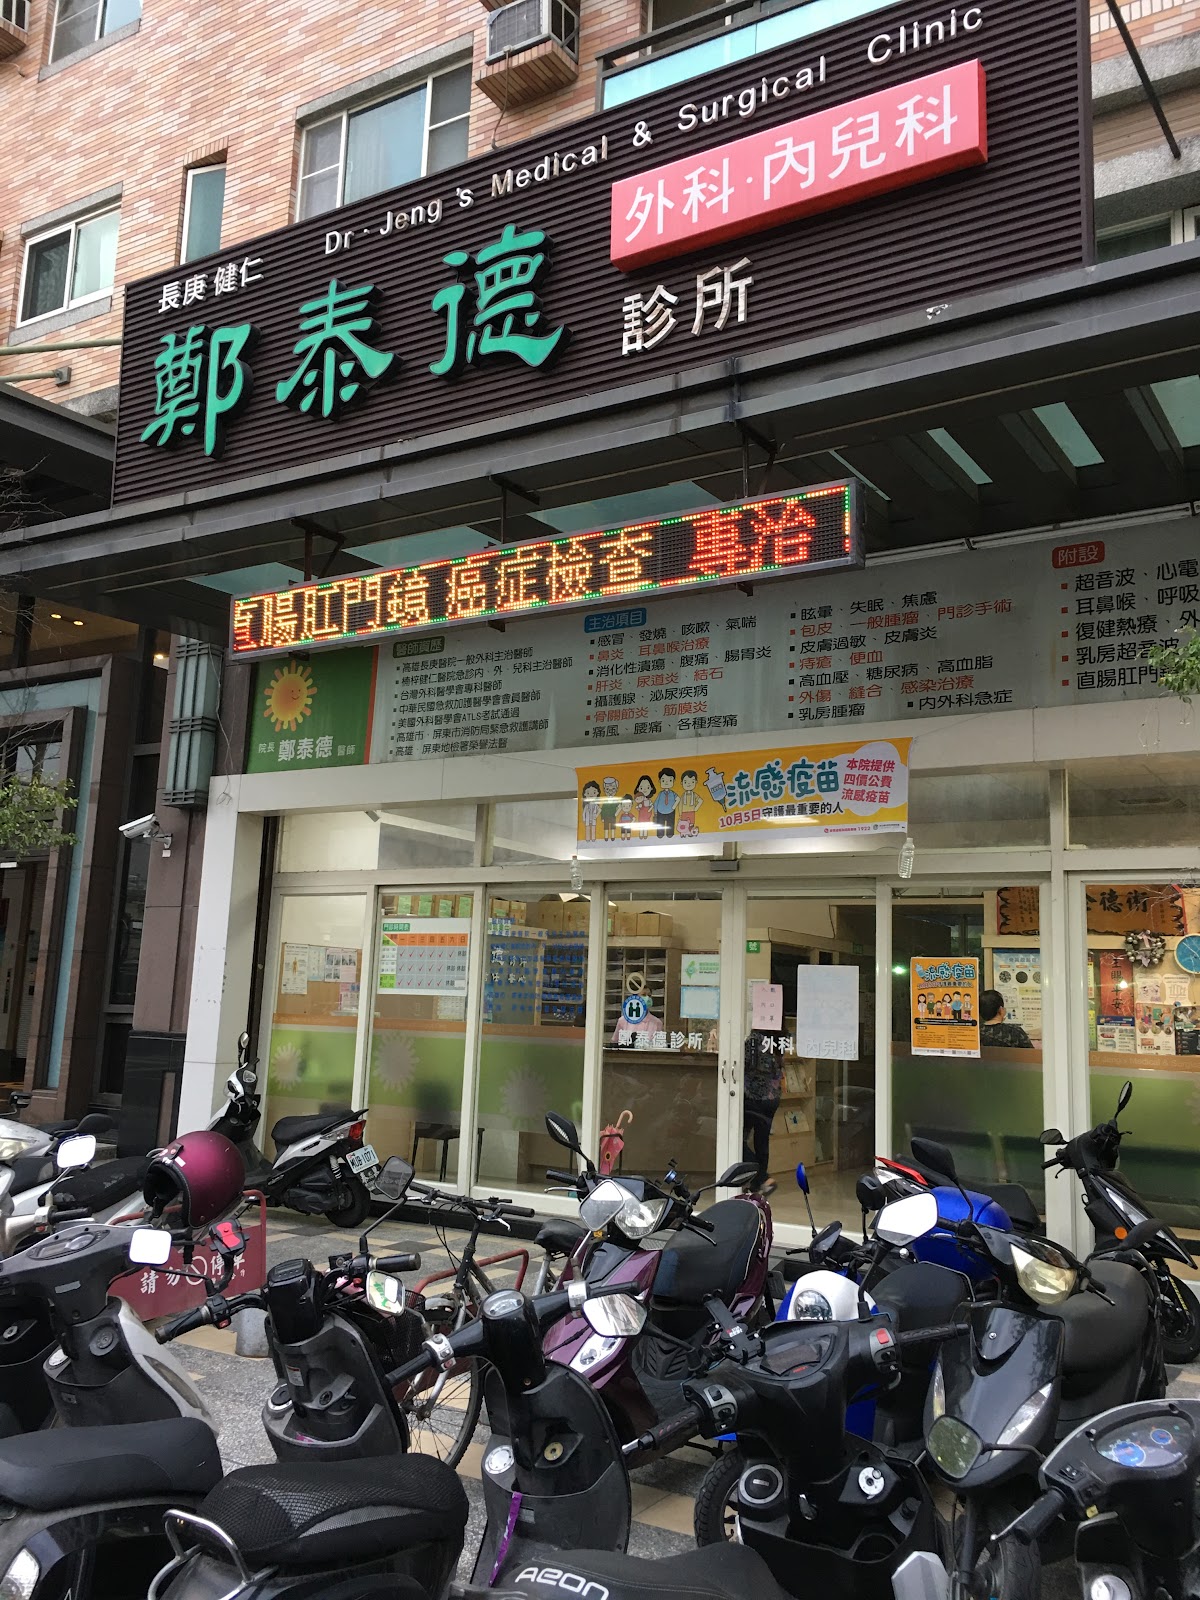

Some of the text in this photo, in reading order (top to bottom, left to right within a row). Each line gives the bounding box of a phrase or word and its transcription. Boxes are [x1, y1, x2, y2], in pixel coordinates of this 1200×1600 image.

[491, 135, 608, 199] Medical
[632, 121, 654, 148] &
[677, 56, 826, 132] Surgical
[867, 6, 983, 65] Clinic
[621, 257, 755, 357] 診所
[140, 224, 566, 457] 鄭泰德
[446, 530, 652, 617] 癌症檢查
[689, 500, 816, 574] 專治
[1058, 544, 1099, 566] 附設
[588, 610, 643, 631] 主治項目
[798, 703, 865, 721] 乳房腫瘤
[278, 735, 334, 762] 鄭泰德
[846, 758, 895, 773] 本院提供
[727, 758, 840, 807] 流感疫苗
[841, 788, 891, 804] 流感疫苗
[618, 1030, 703, 1050] 鄭泰德診所
[761, 1035, 795, 1055] 外科
